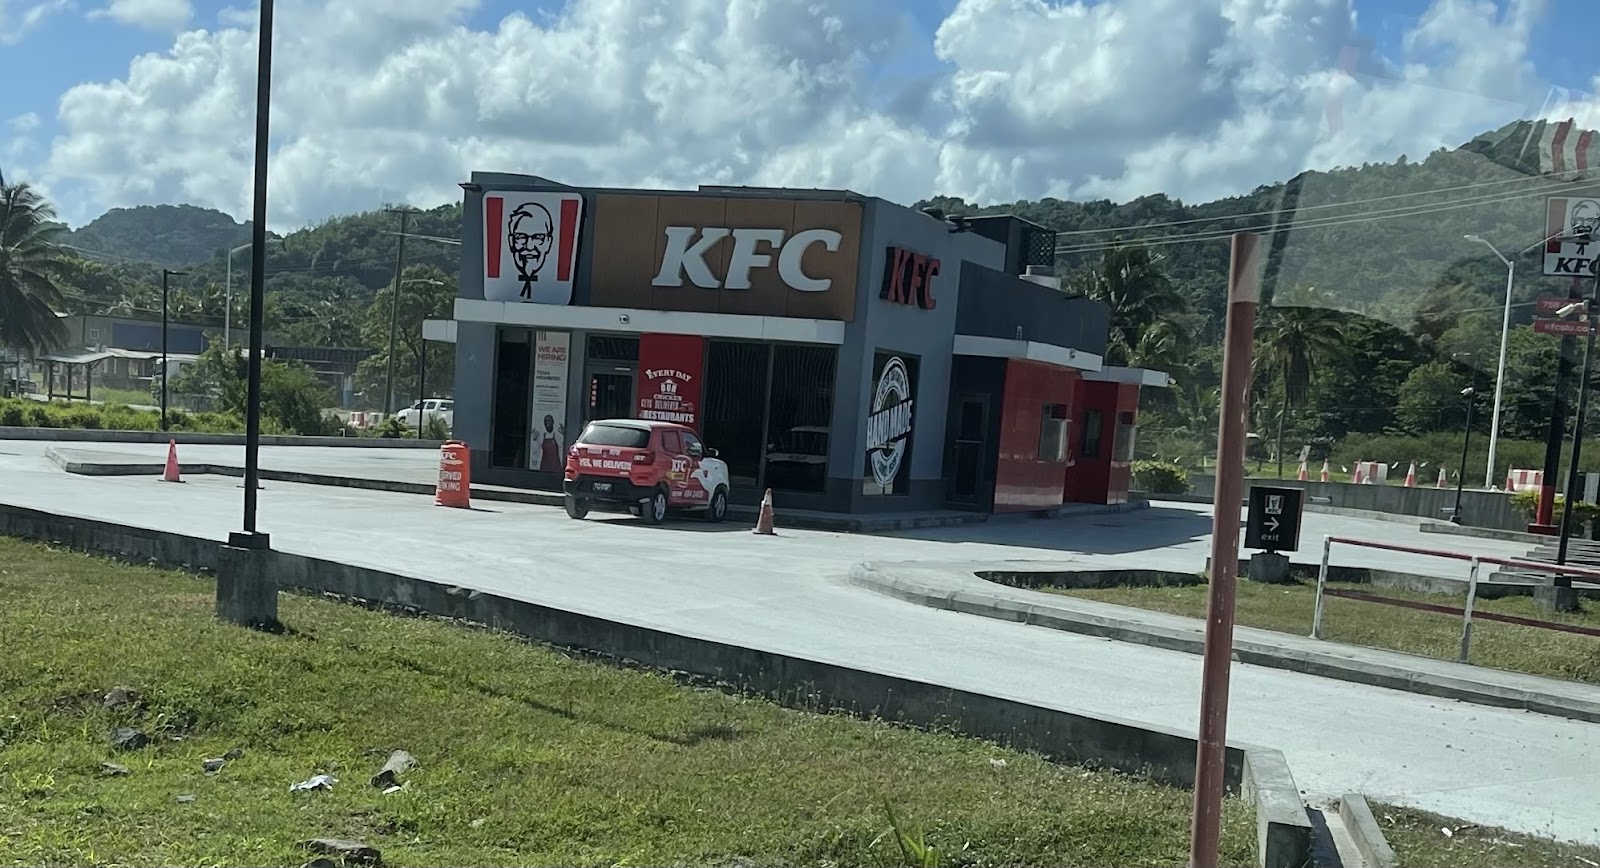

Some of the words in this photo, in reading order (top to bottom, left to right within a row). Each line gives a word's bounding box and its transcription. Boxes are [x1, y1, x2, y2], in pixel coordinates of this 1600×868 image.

[651, 226, 843, 293] KFC
[880, 246, 941, 311] KFC
[1544, 323, 1590, 333] kfcslu.co
[552, 346, 567, 354] ARE
[537, 353, 567, 361] HIRING!
[675, 370, 692, 382] DAY
[660, 383, 677, 393] OUR
[643, 410, 695, 423] RESTAURANTS
[866, 400, 914, 451] HANDMADE
[592, 459, 603, 468] WE
[671, 459, 687, 473] KFC
[1260, 533, 1280, 541] exit
